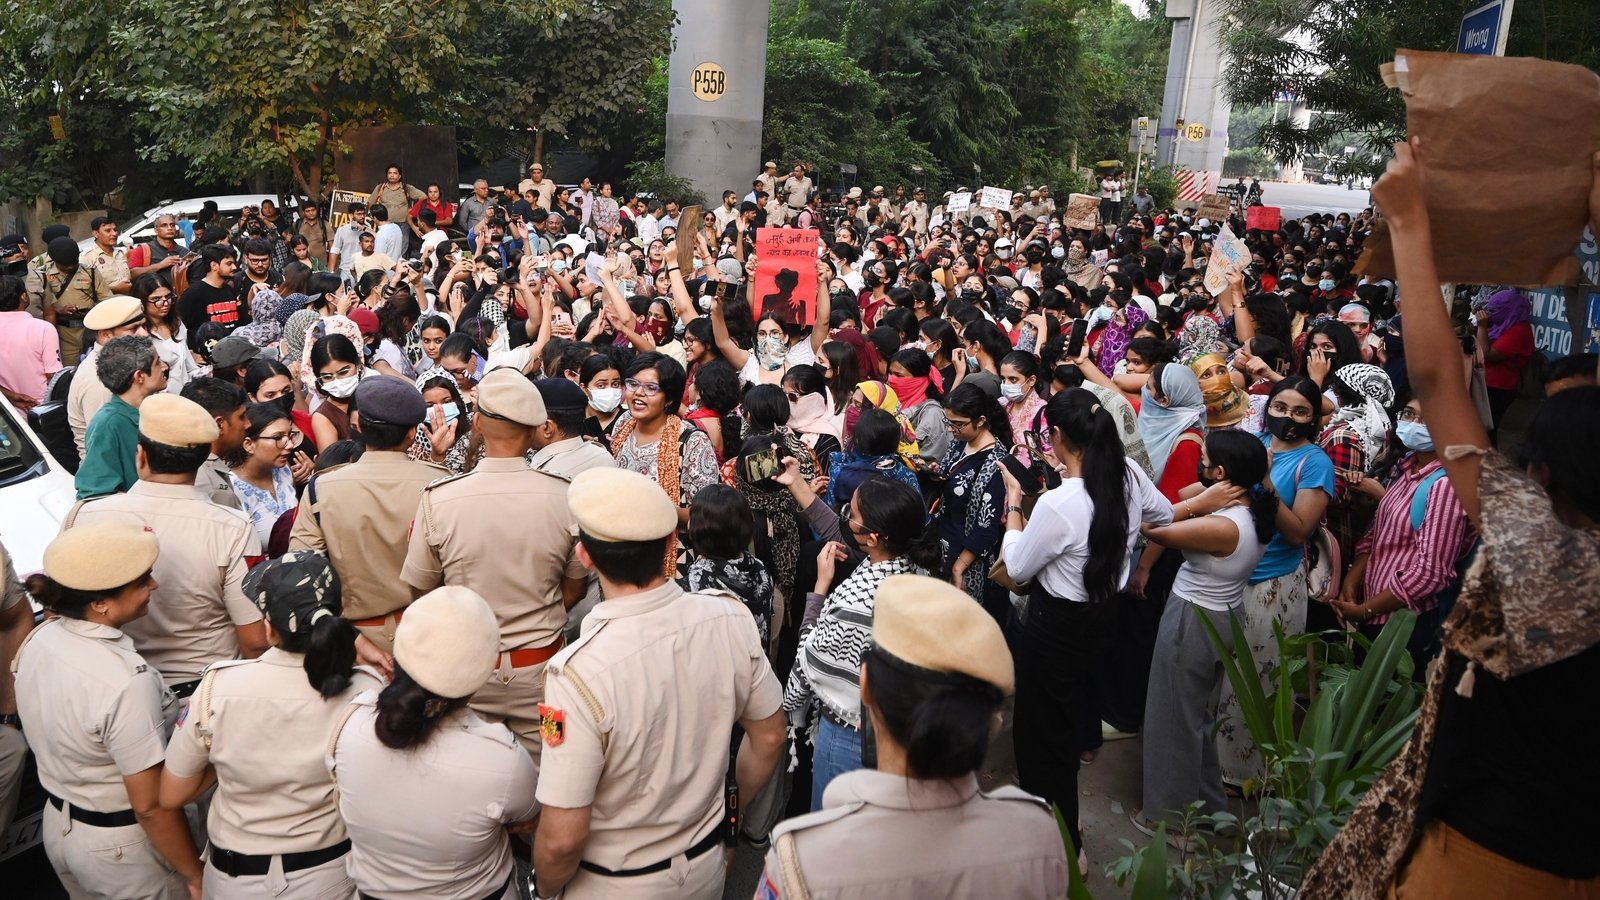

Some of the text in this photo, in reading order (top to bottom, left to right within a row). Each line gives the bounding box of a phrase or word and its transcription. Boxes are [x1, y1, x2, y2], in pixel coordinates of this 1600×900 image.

[1464, 28, 1490, 50] Wrong
[1547, 294, 1569, 323] DE
[1530, 323, 1573, 356] CATIO
